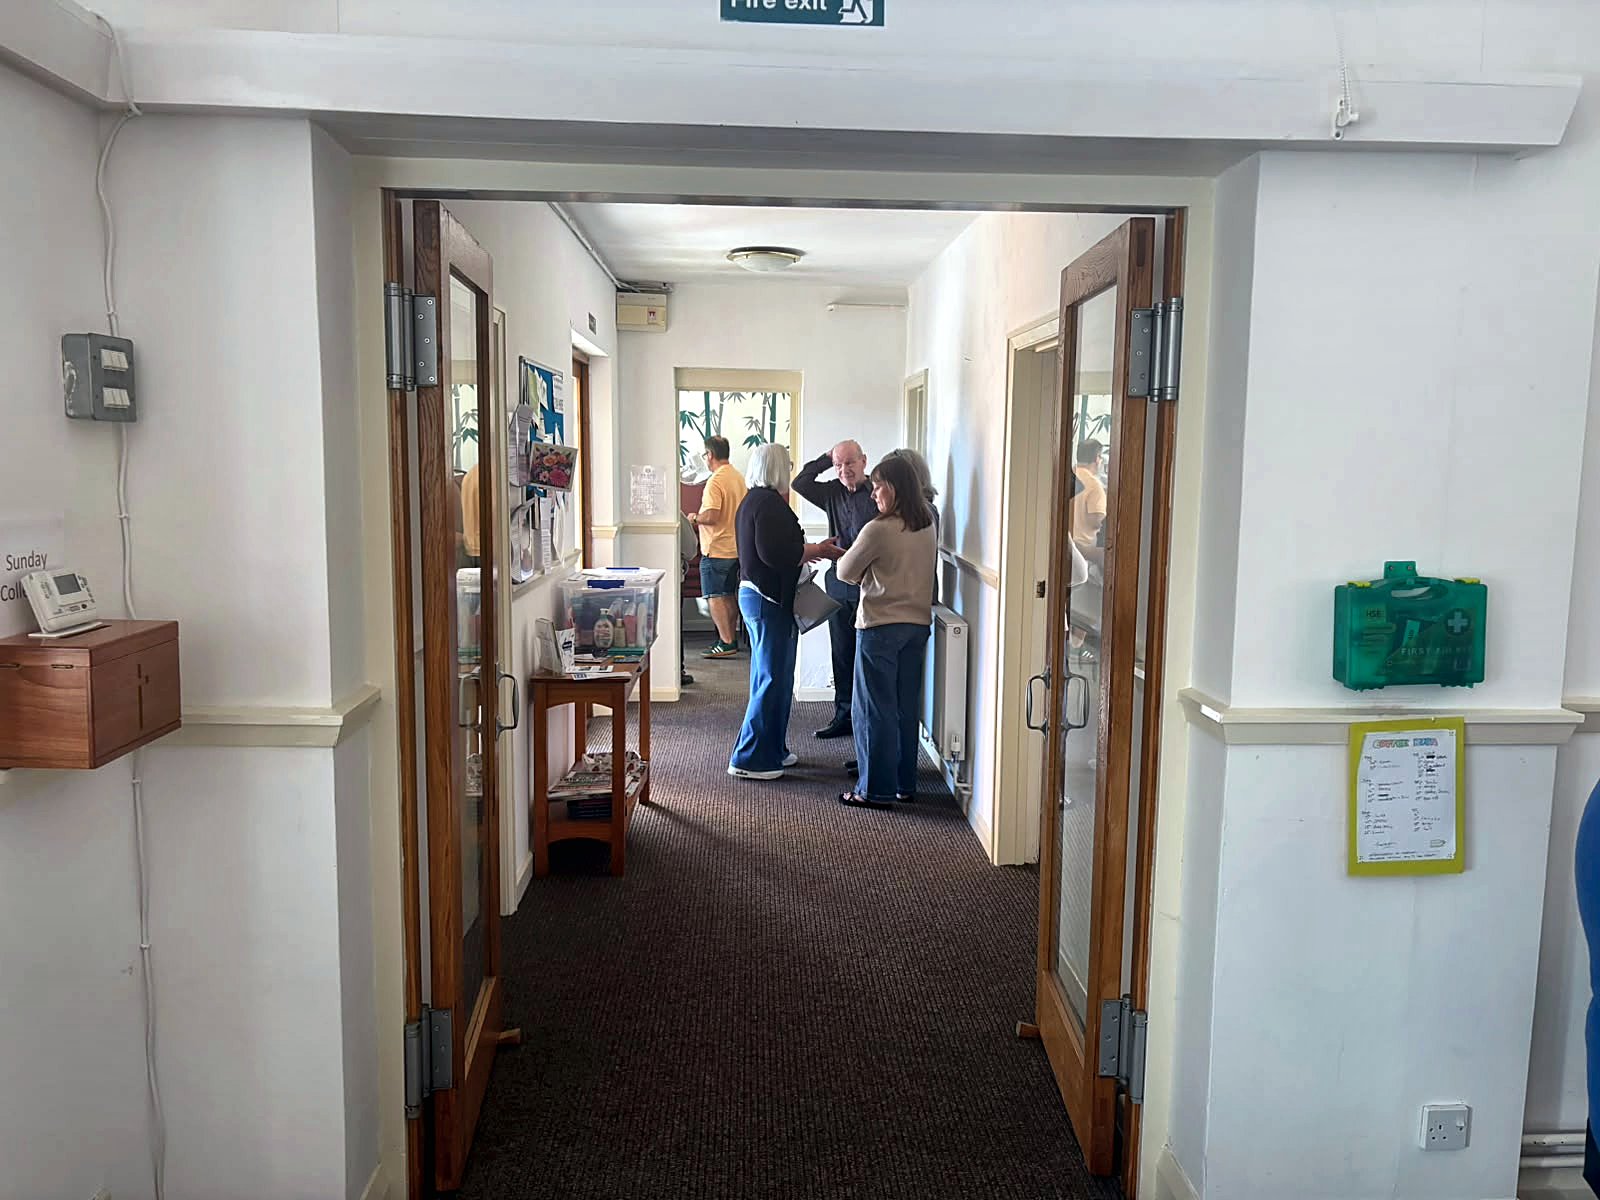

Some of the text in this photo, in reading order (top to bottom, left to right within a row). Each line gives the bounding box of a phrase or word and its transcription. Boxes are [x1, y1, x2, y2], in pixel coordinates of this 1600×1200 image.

[784, 0, 828, 10] exit
[6, 549, 47, 571] Sunday
[1400, 647, 1431, 657] FIRST
